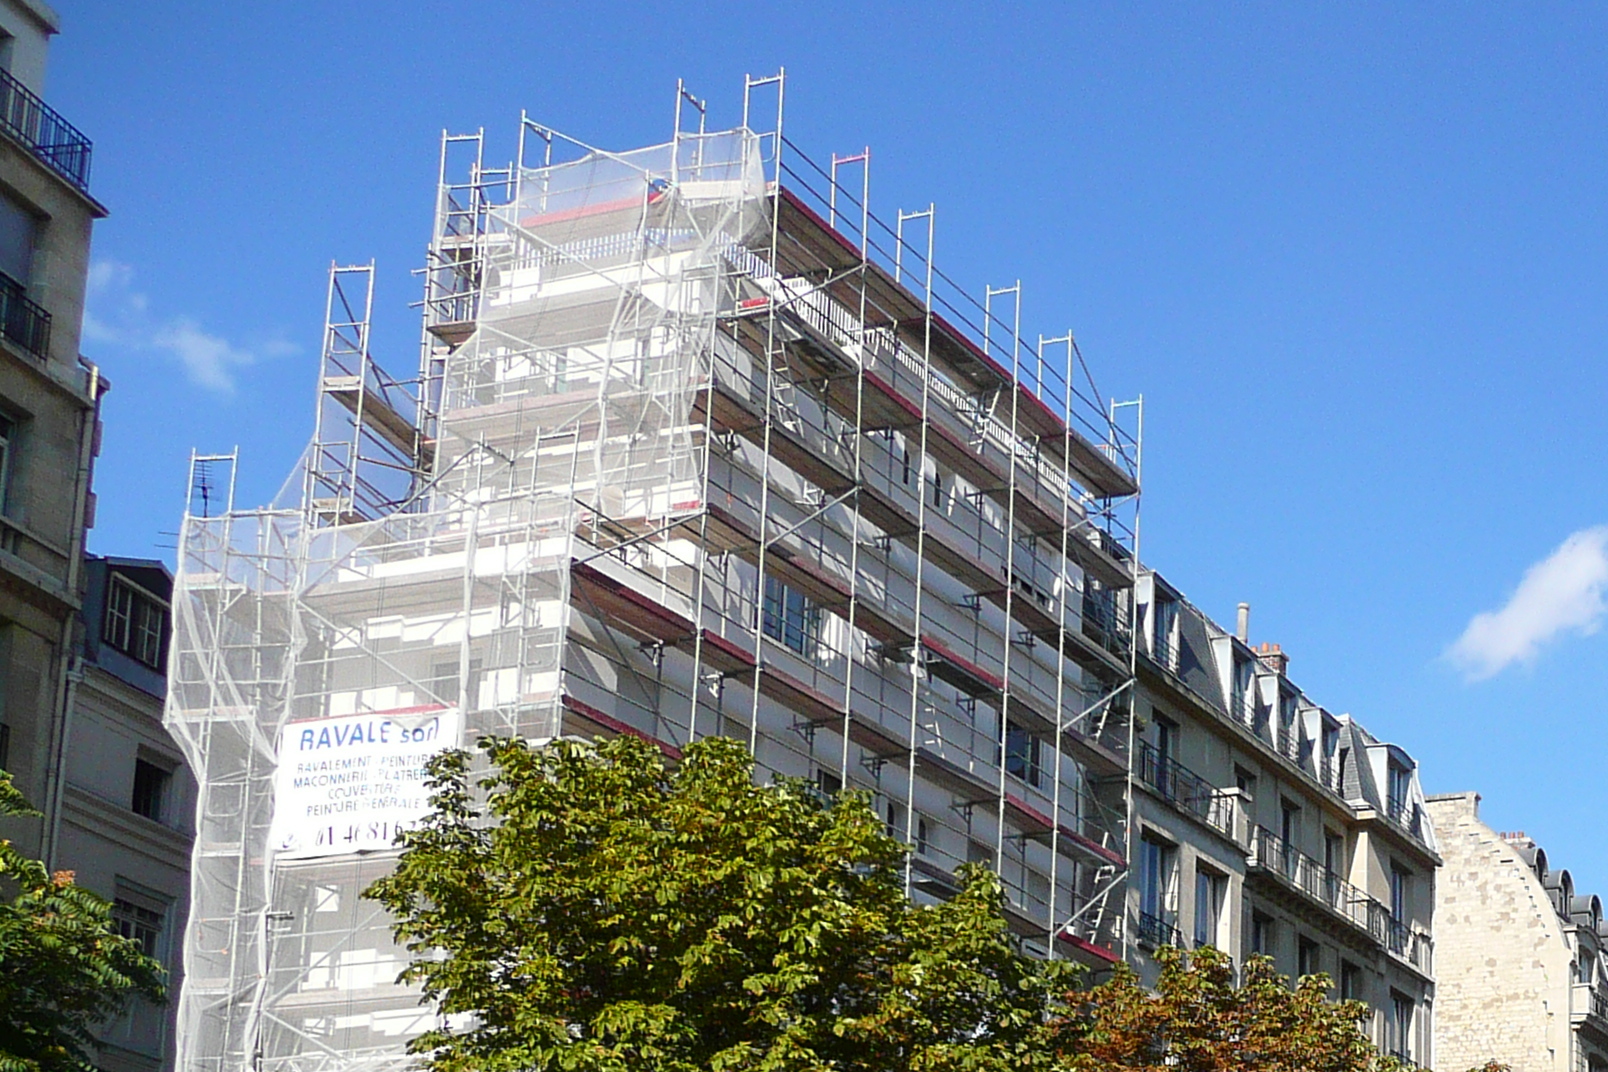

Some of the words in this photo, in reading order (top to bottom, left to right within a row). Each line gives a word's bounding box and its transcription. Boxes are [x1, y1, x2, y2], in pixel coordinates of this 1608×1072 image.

[300, 721, 391, 751] RAVALE
[400, 717, 439, 743] sarl
[297, 755, 371, 774] RAVALEMENT
[381, 753, 434, 768] PEINTUR
[307, 799, 359, 817] PEINTURE
